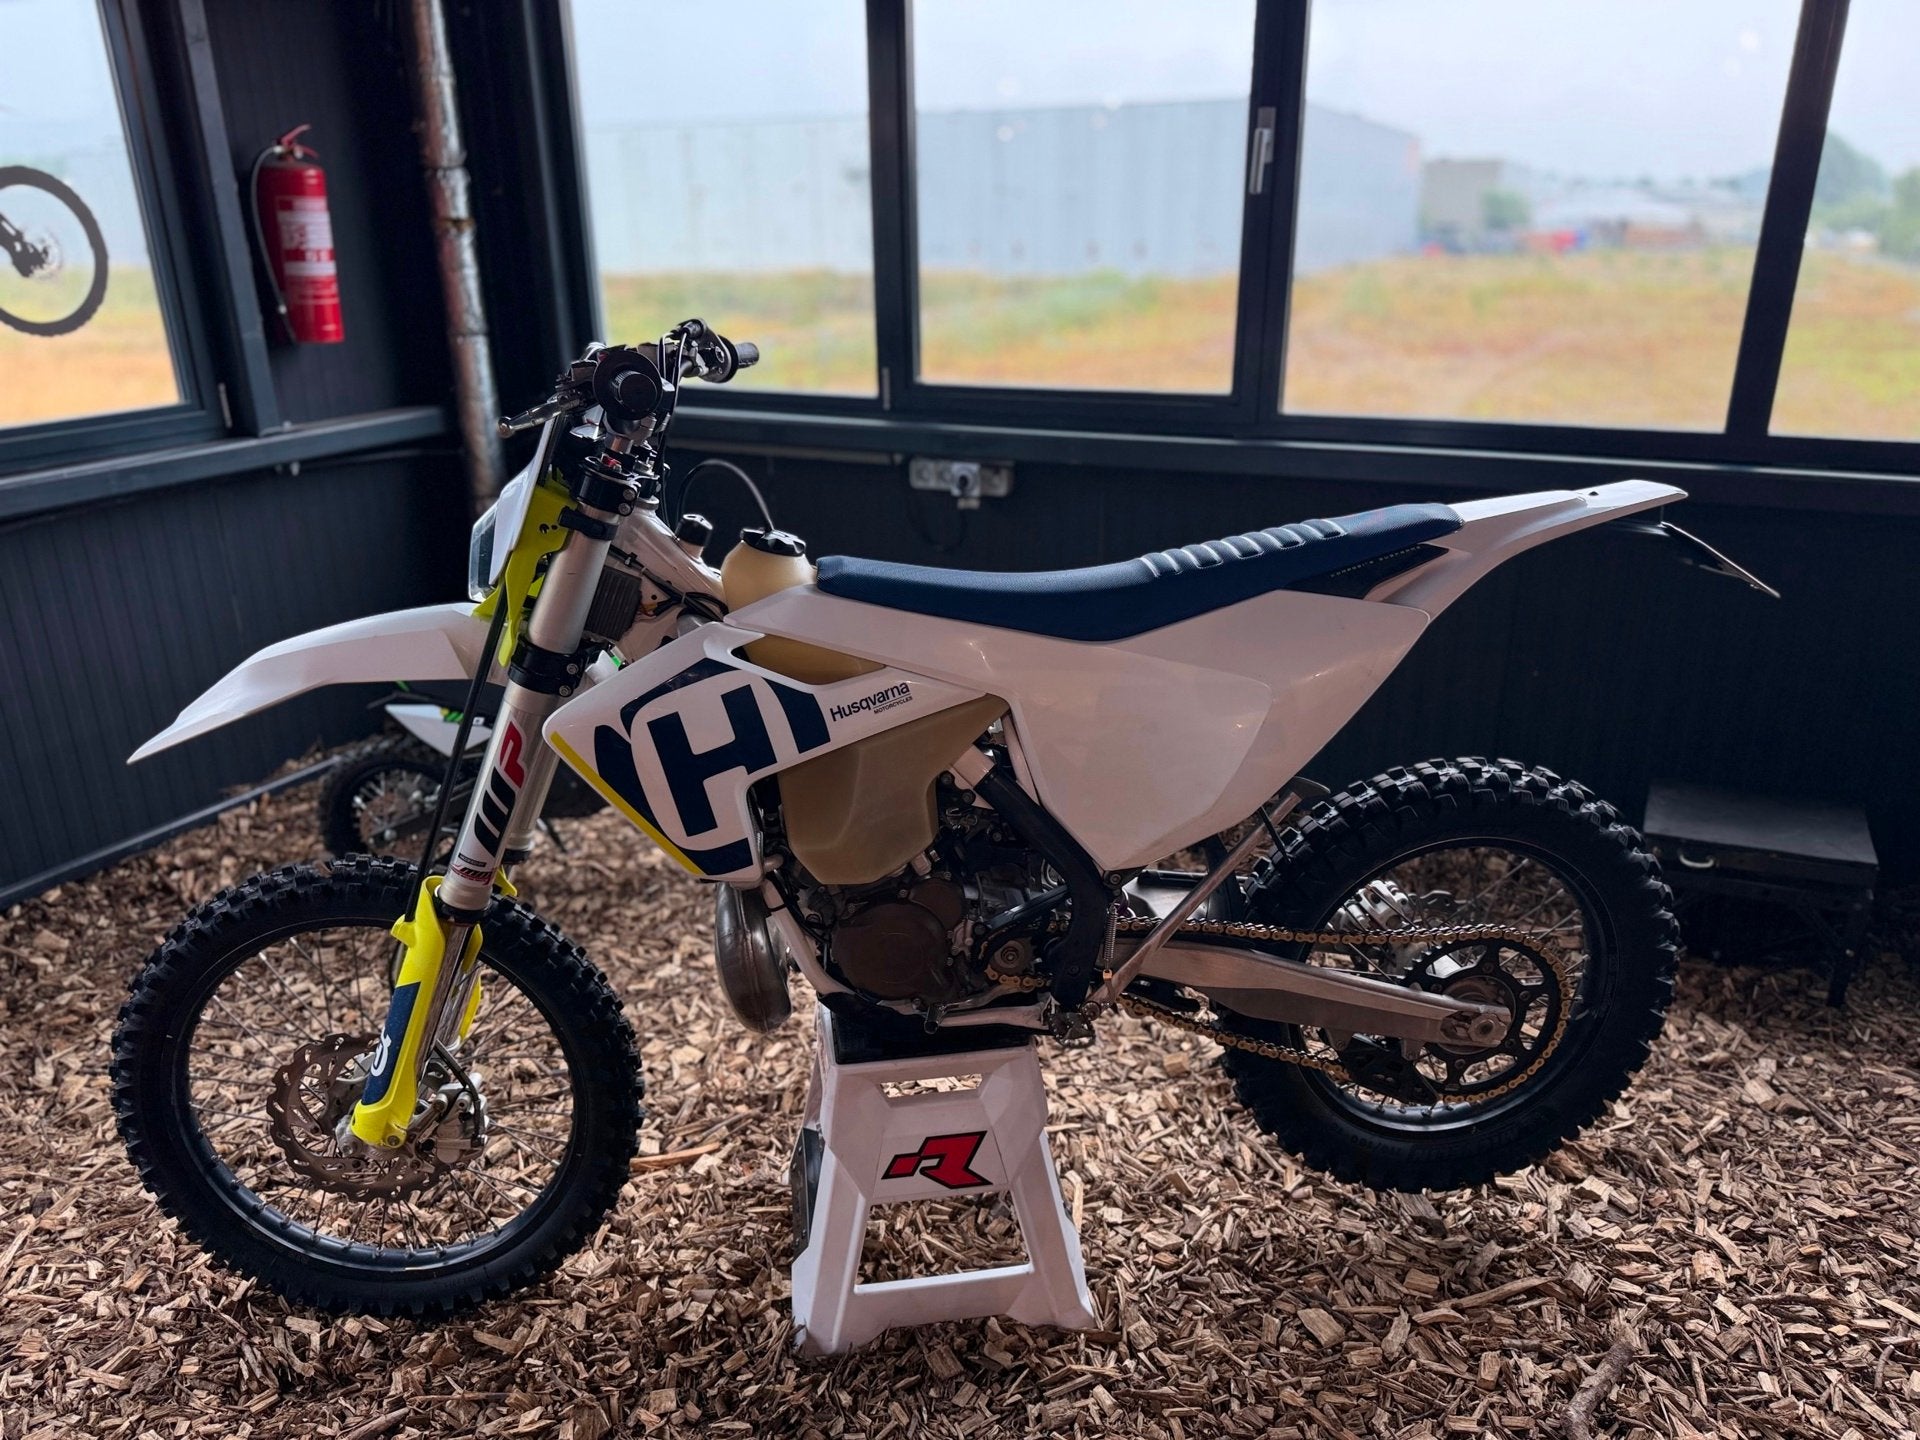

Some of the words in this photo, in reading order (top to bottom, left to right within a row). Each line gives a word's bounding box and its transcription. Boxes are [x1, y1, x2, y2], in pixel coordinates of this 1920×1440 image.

[829, 682, 910, 722] Husqvarna
[873, 696, 913, 714] MOTORCYCLES
[647, 684, 777, 836] H
